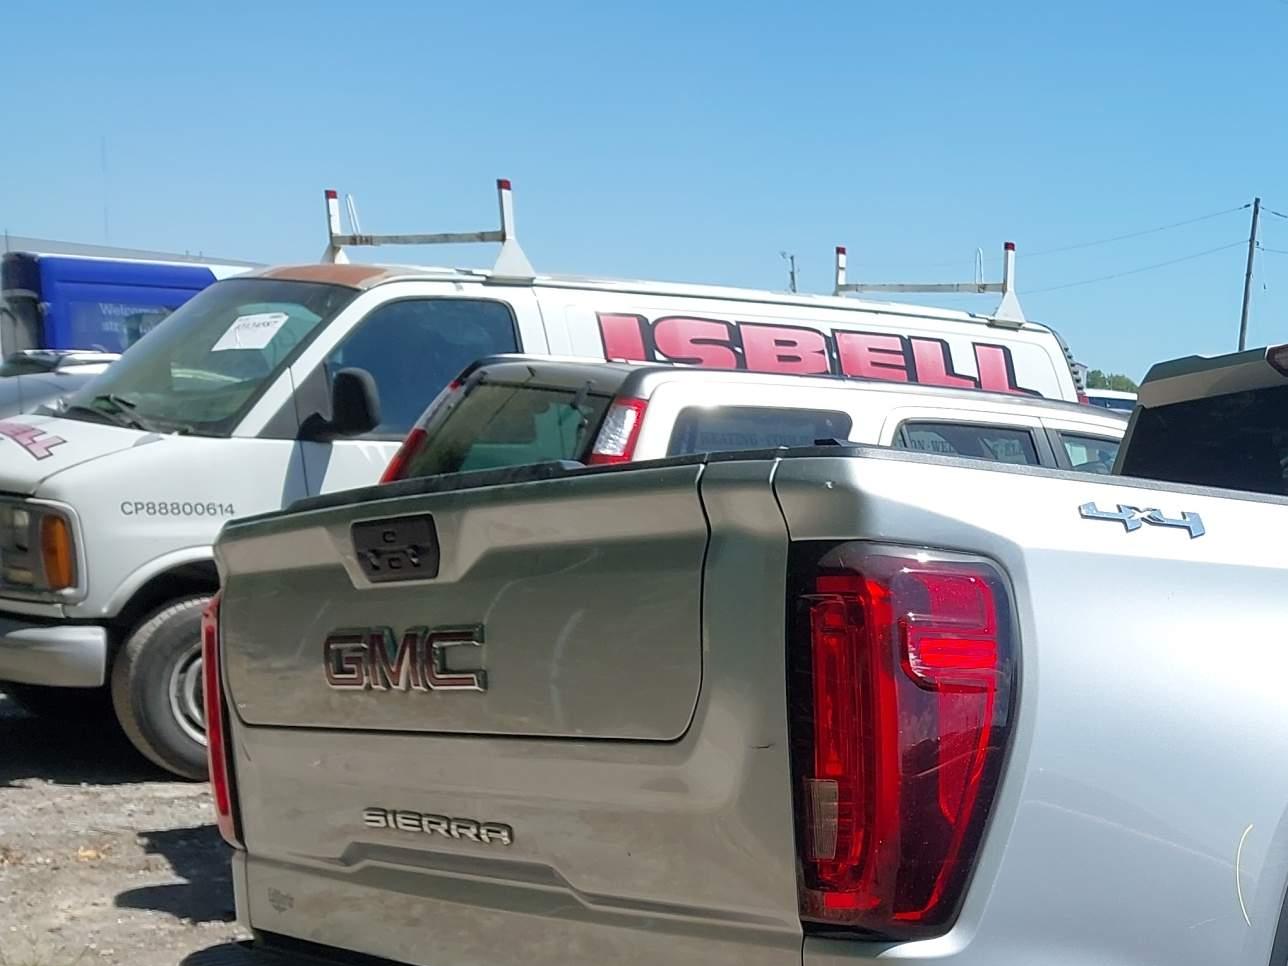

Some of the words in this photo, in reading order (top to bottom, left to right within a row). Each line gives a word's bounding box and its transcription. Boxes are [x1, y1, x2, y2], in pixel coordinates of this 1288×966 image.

[596, 312, 1042, 398] ISBELL
[120, 501, 235, 516] CP88800614
[324, 622, 487, 692] GMC
[363, 807, 514, 845] SIERRA
